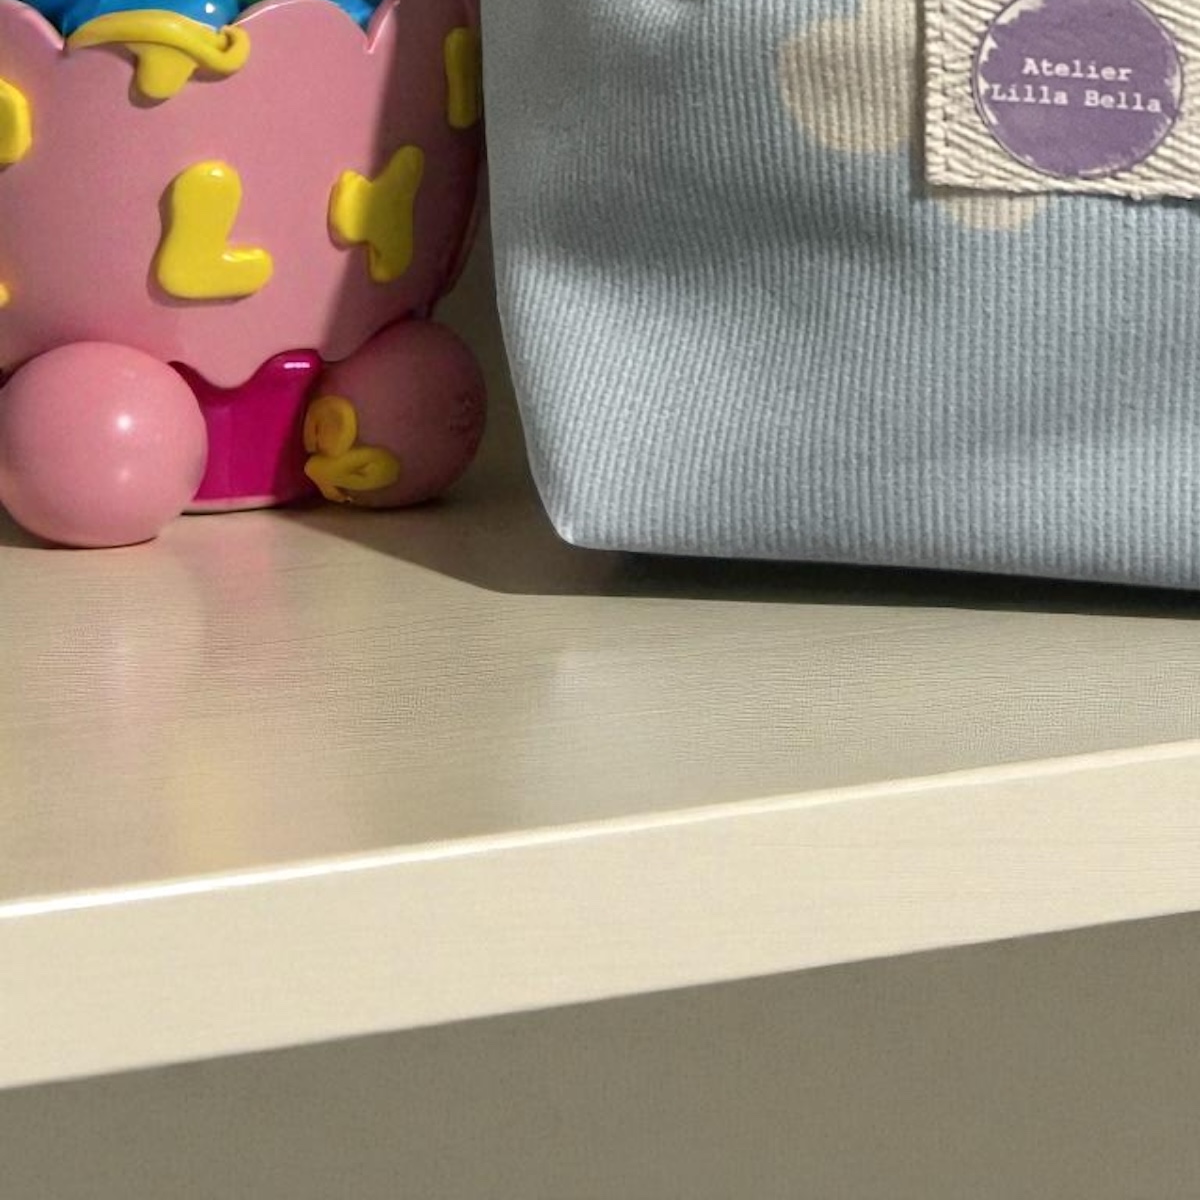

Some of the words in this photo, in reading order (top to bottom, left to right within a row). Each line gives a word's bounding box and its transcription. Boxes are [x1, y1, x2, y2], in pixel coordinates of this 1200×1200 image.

[1022, 57, 1132, 81] Atelier
[991, 83, 1068, 105] Lilla
[1084, 89, 1161, 112] Bella
